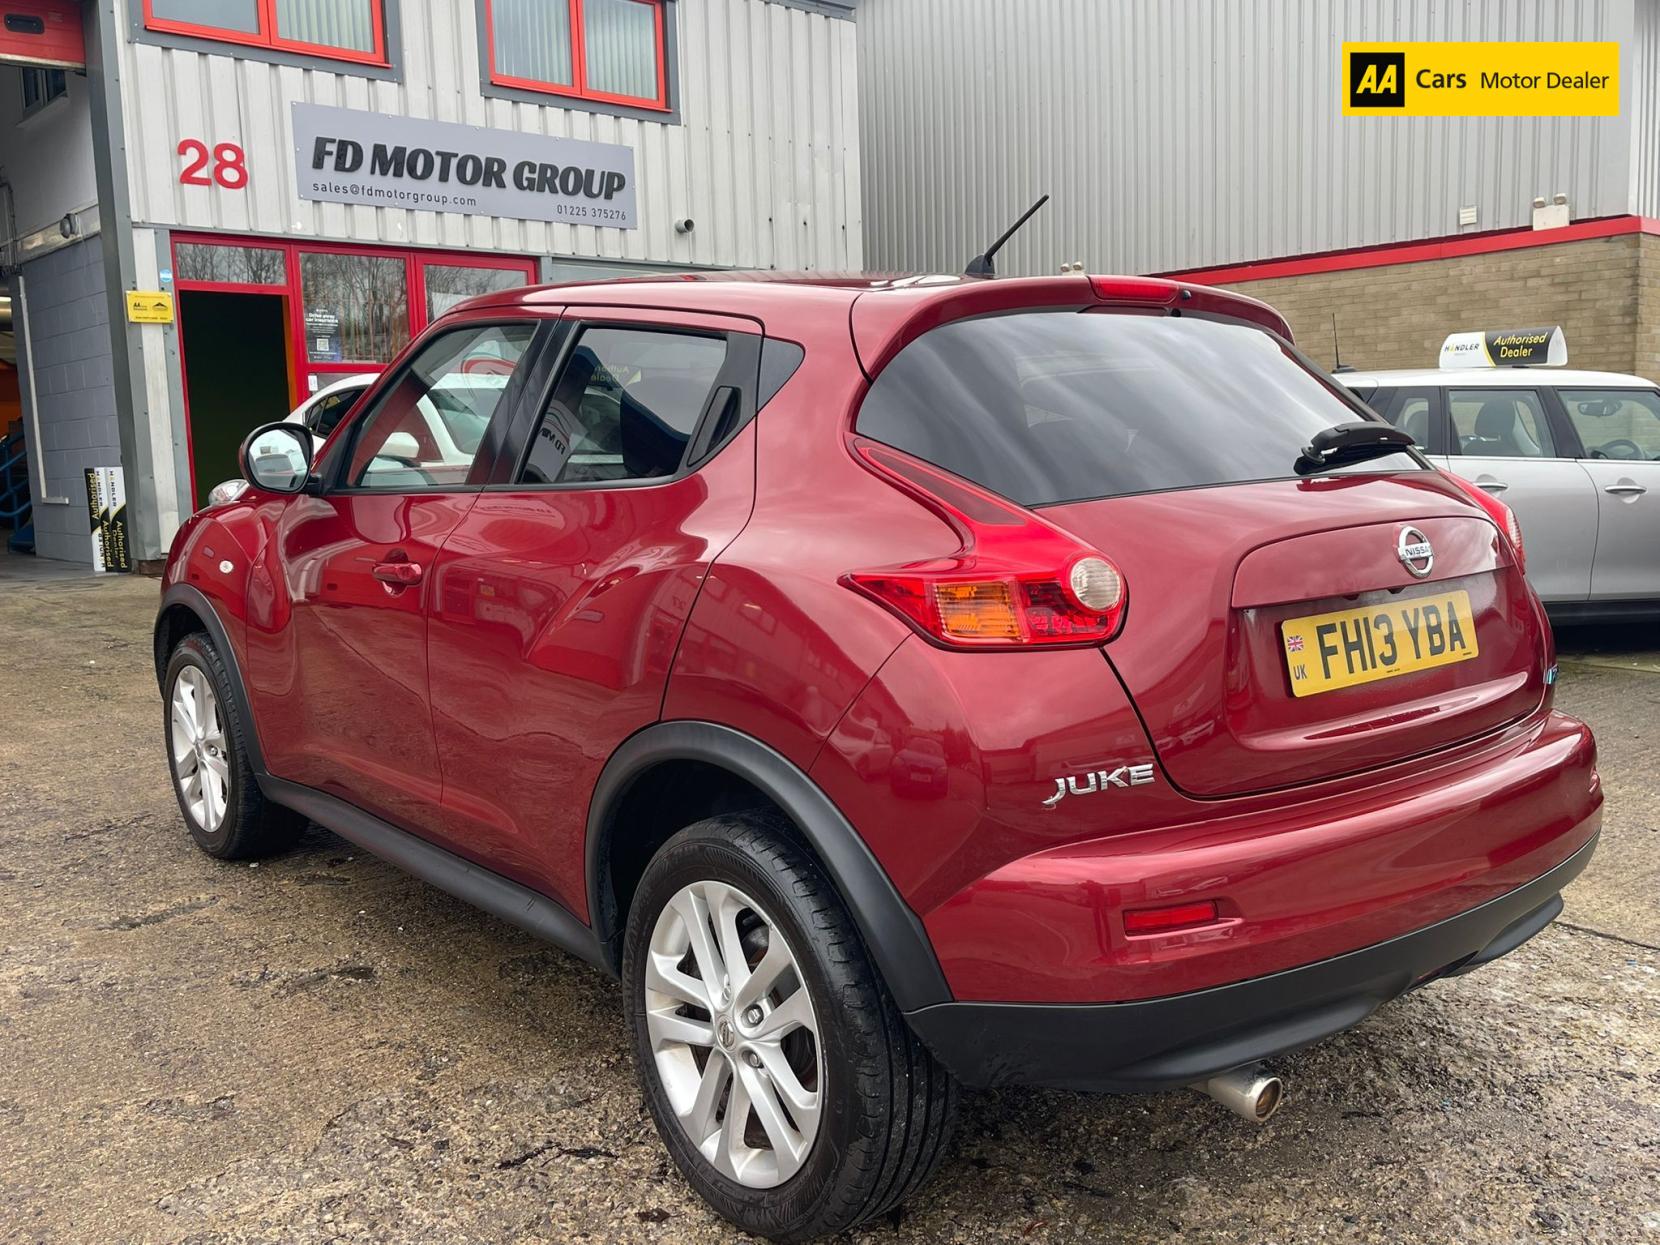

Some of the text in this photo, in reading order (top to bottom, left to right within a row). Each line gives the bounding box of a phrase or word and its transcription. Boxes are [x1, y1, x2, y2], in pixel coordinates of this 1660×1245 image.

[177, 139, 248, 189] 28
[312, 136, 627, 200] FD MOTOR GROUP
[312, 181, 477, 206] sales@fdmotorgroup.com
[556, 204, 627, 220] 01225 375276
[1493, 332, 1548, 346] Authorised
[1500, 346, 1533, 358] Dealer
[116, 520, 128, 568] Authorised
[1316, 601, 1467, 679] FH13 YBA
[1293, 664, 1308, 680] UK
[1042, 763, 1156, 806] JUKE
